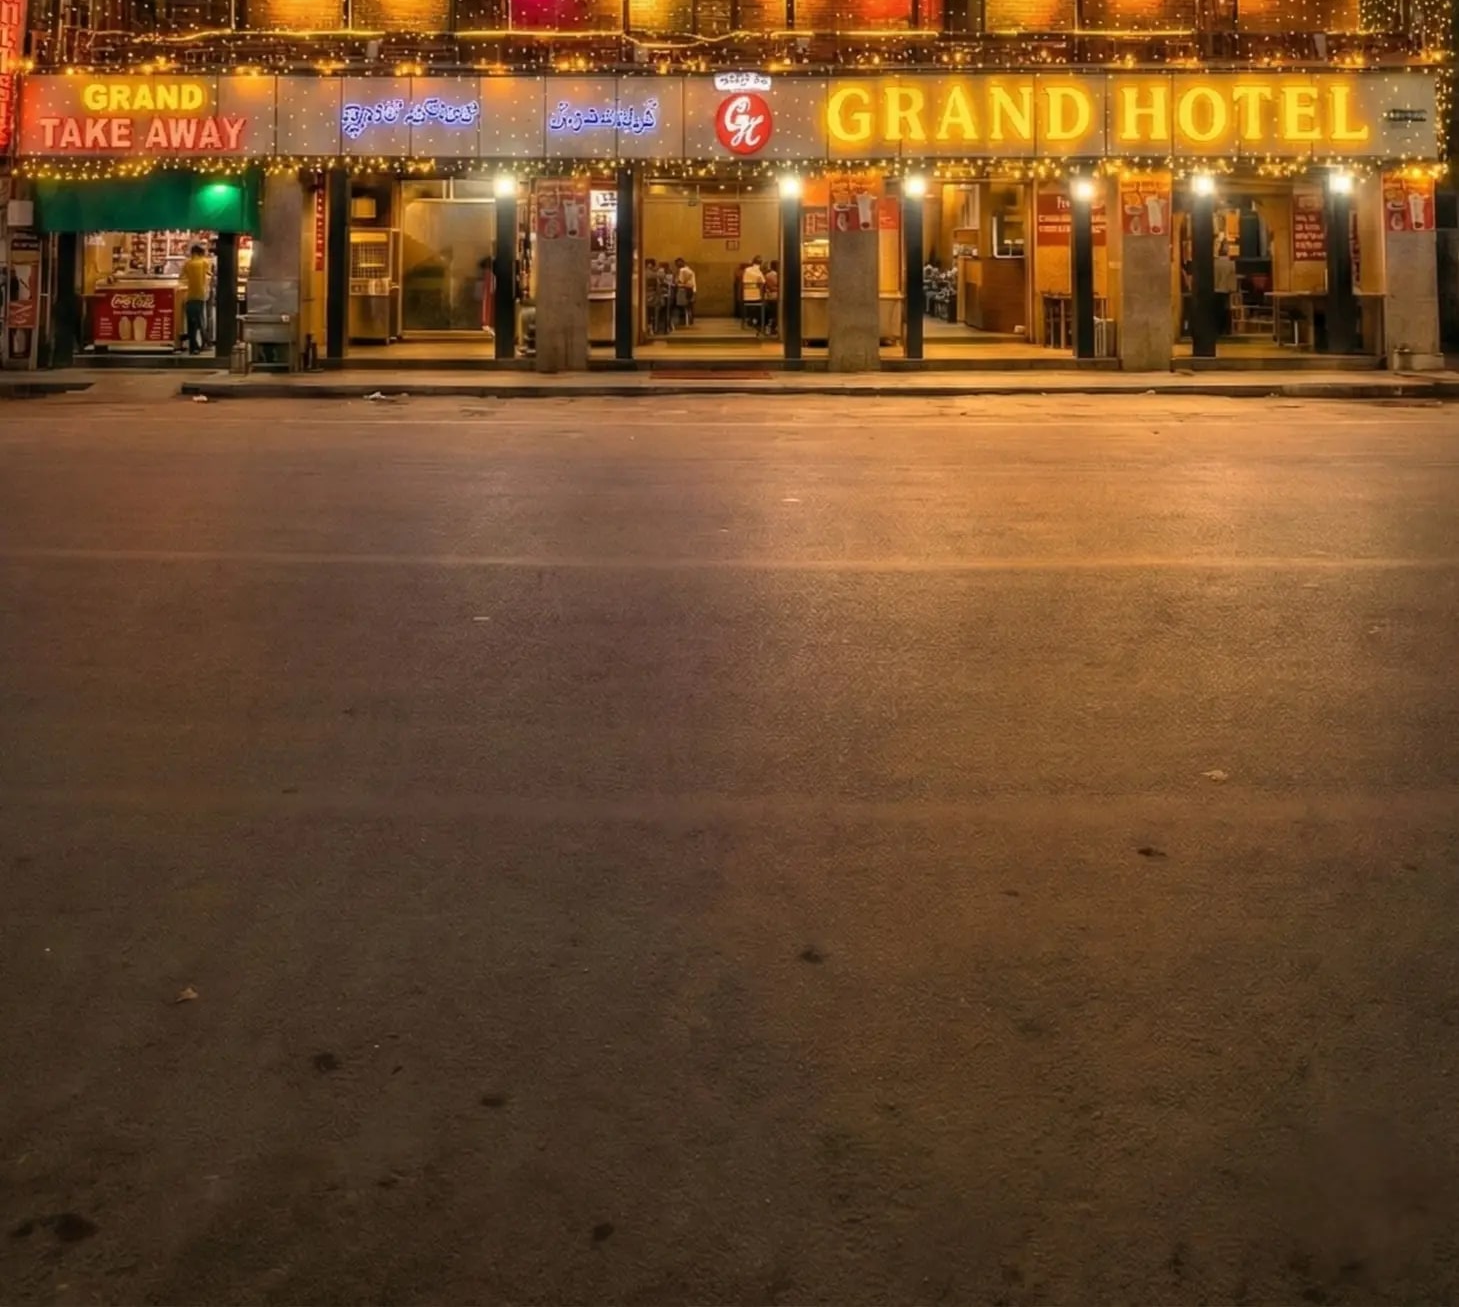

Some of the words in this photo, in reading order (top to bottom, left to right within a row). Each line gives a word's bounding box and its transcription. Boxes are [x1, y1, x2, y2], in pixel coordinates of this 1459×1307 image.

[83, 83, 203, 111] GRAND
[827, 86, 1093, 142] GRAND
[1121, 86, 1369, 141] HOTEL
[40, 118, 132, 148] TAKE
[146, 118, 247, 149] AWAY
